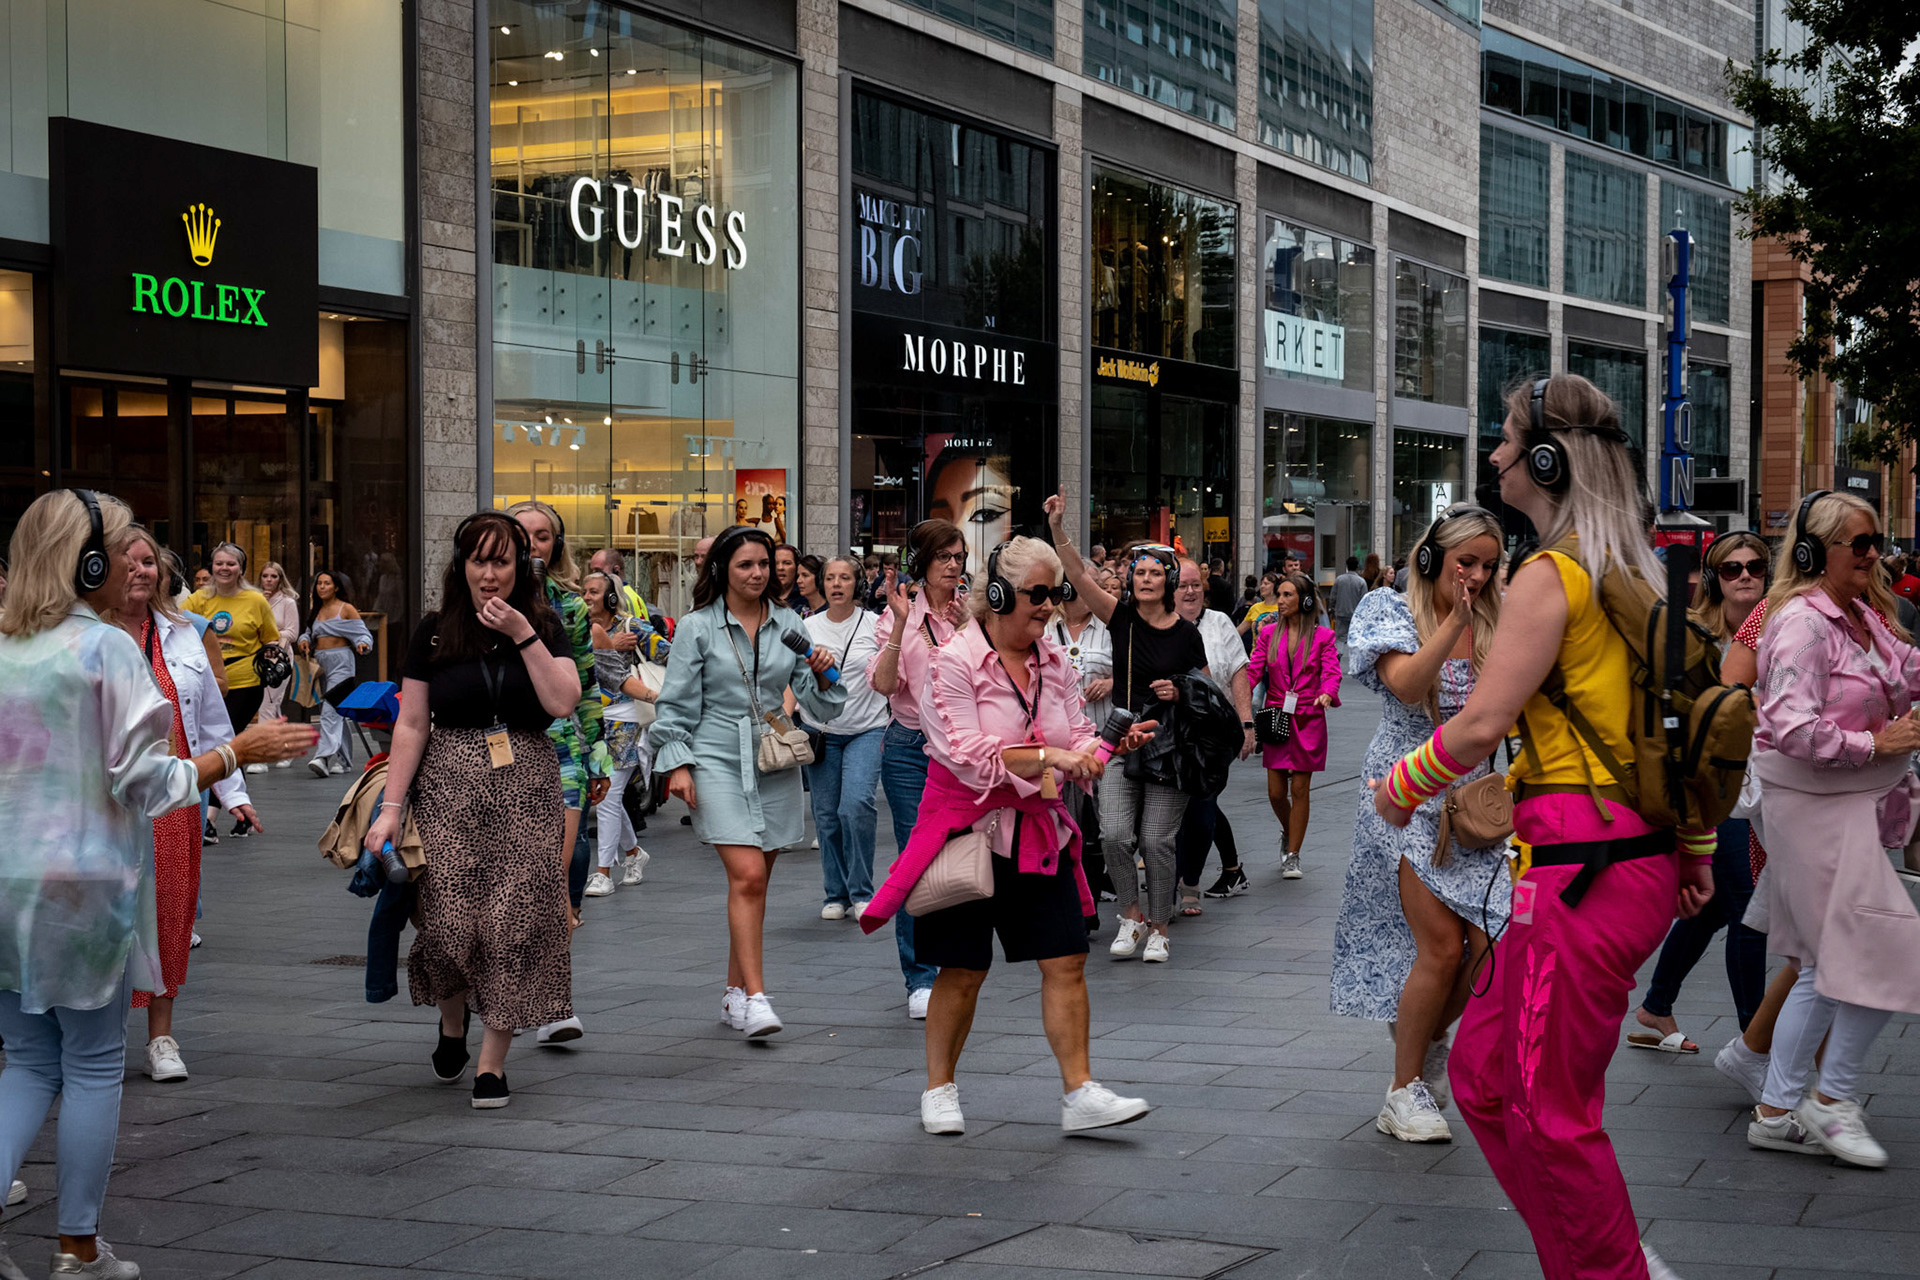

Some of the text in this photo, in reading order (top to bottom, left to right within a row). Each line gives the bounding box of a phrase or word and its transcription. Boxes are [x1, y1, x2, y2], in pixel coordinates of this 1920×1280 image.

[569, 176, 748, 271] GUESS
[859, 193, 926, 232] MAKE IT
[860, 224, 924, 295] BIG
[131, 272, 269, 327] ROLEX
[903, 333, 1026, 386] MORPHE
[1097, 356, 1149, 382] Jack Wolfskin
[1264, 320, 1342, 371] RKET
